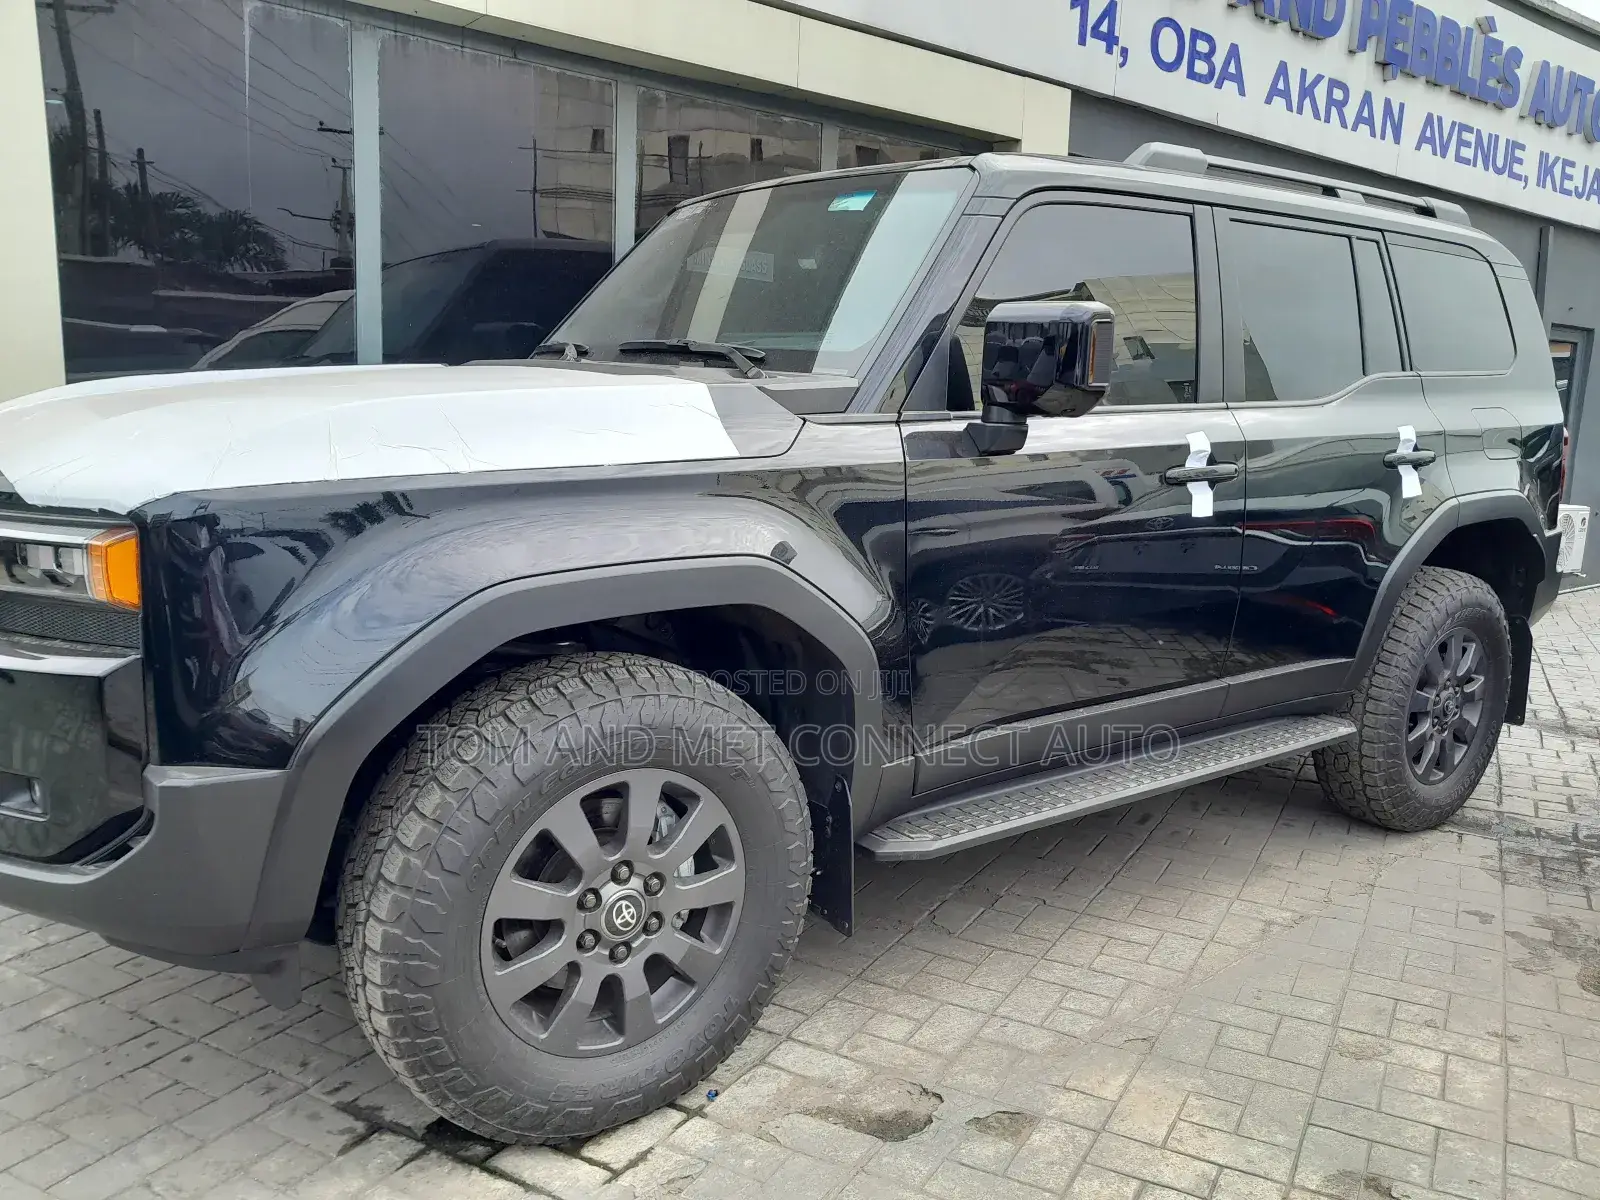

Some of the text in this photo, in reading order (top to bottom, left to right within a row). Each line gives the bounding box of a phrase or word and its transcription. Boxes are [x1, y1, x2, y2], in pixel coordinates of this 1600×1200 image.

[1150, 16, 1246, 97] OBA
[1264, 60, 1405, 145] AKRAN
[1414, 111, 1529, 190] AVENUE,
